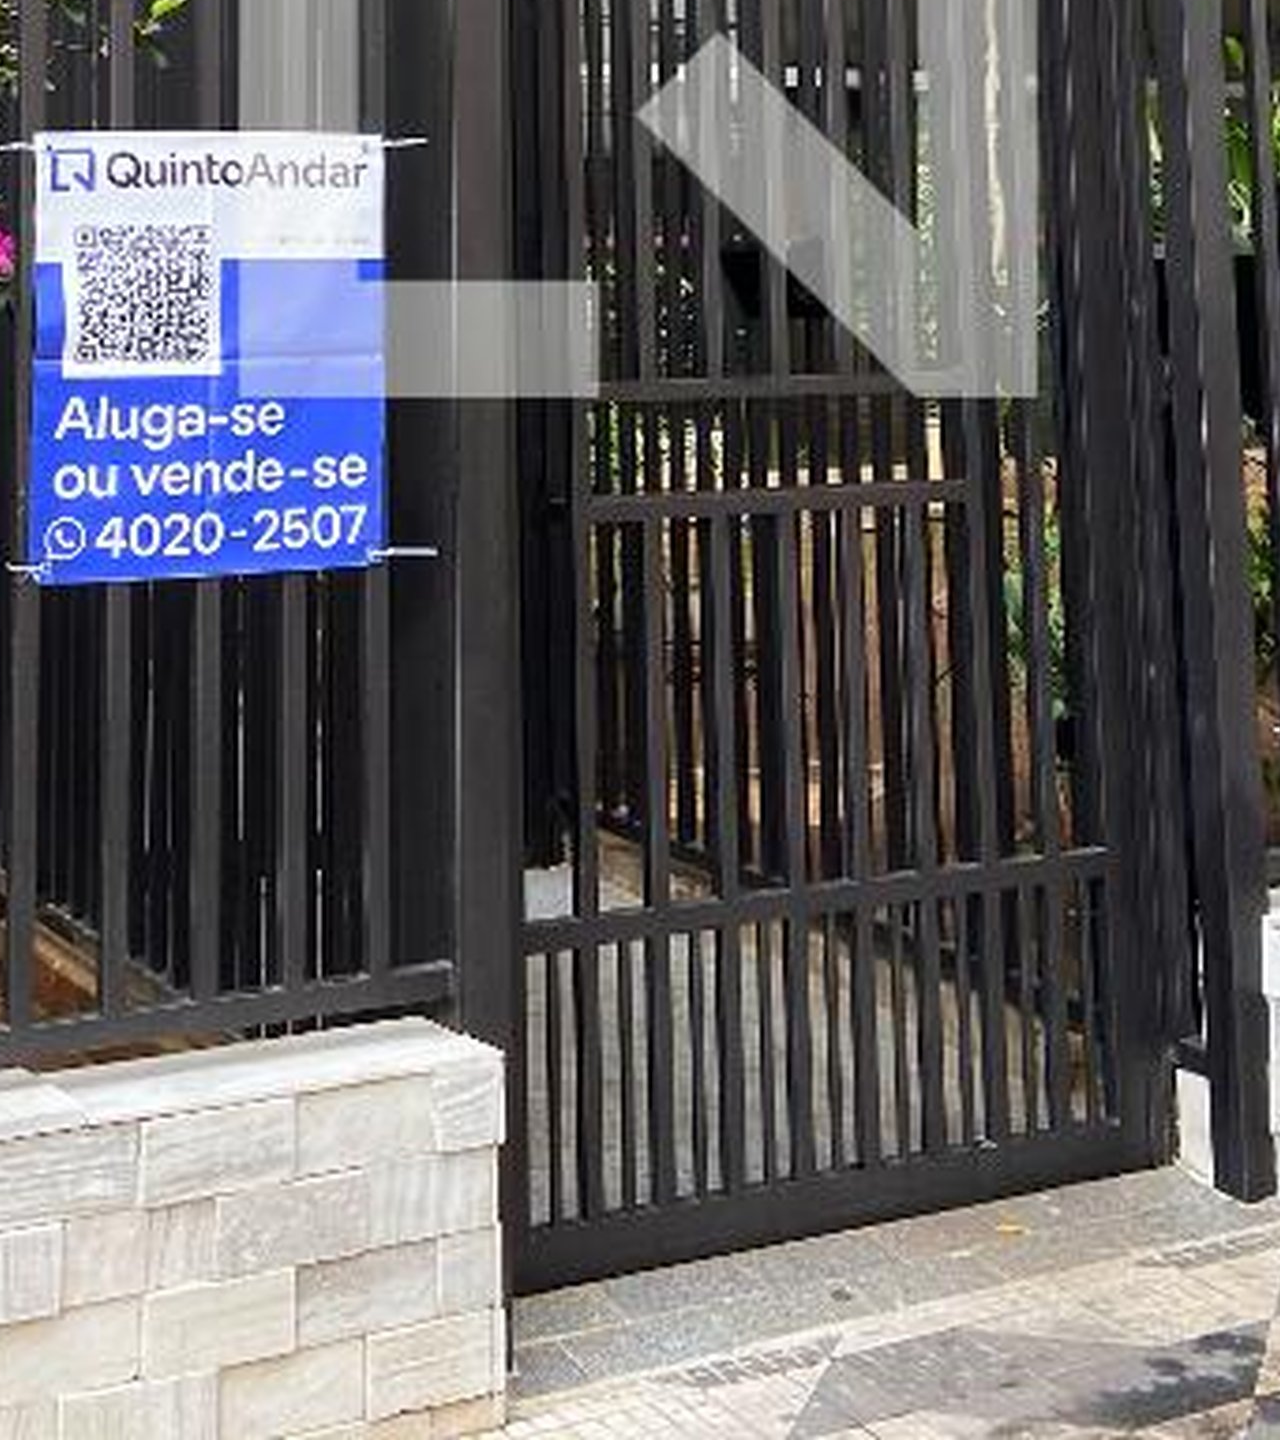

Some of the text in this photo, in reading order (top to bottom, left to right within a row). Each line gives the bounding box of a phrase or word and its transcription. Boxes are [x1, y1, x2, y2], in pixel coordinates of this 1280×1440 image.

[106, 151, 369, 189] QuintoAndar
[54, 395, 286, 451] Aluga-se
[53, 450, 368, 499] ou vende-se
[95, 505, 368, 558] 4020-2507
